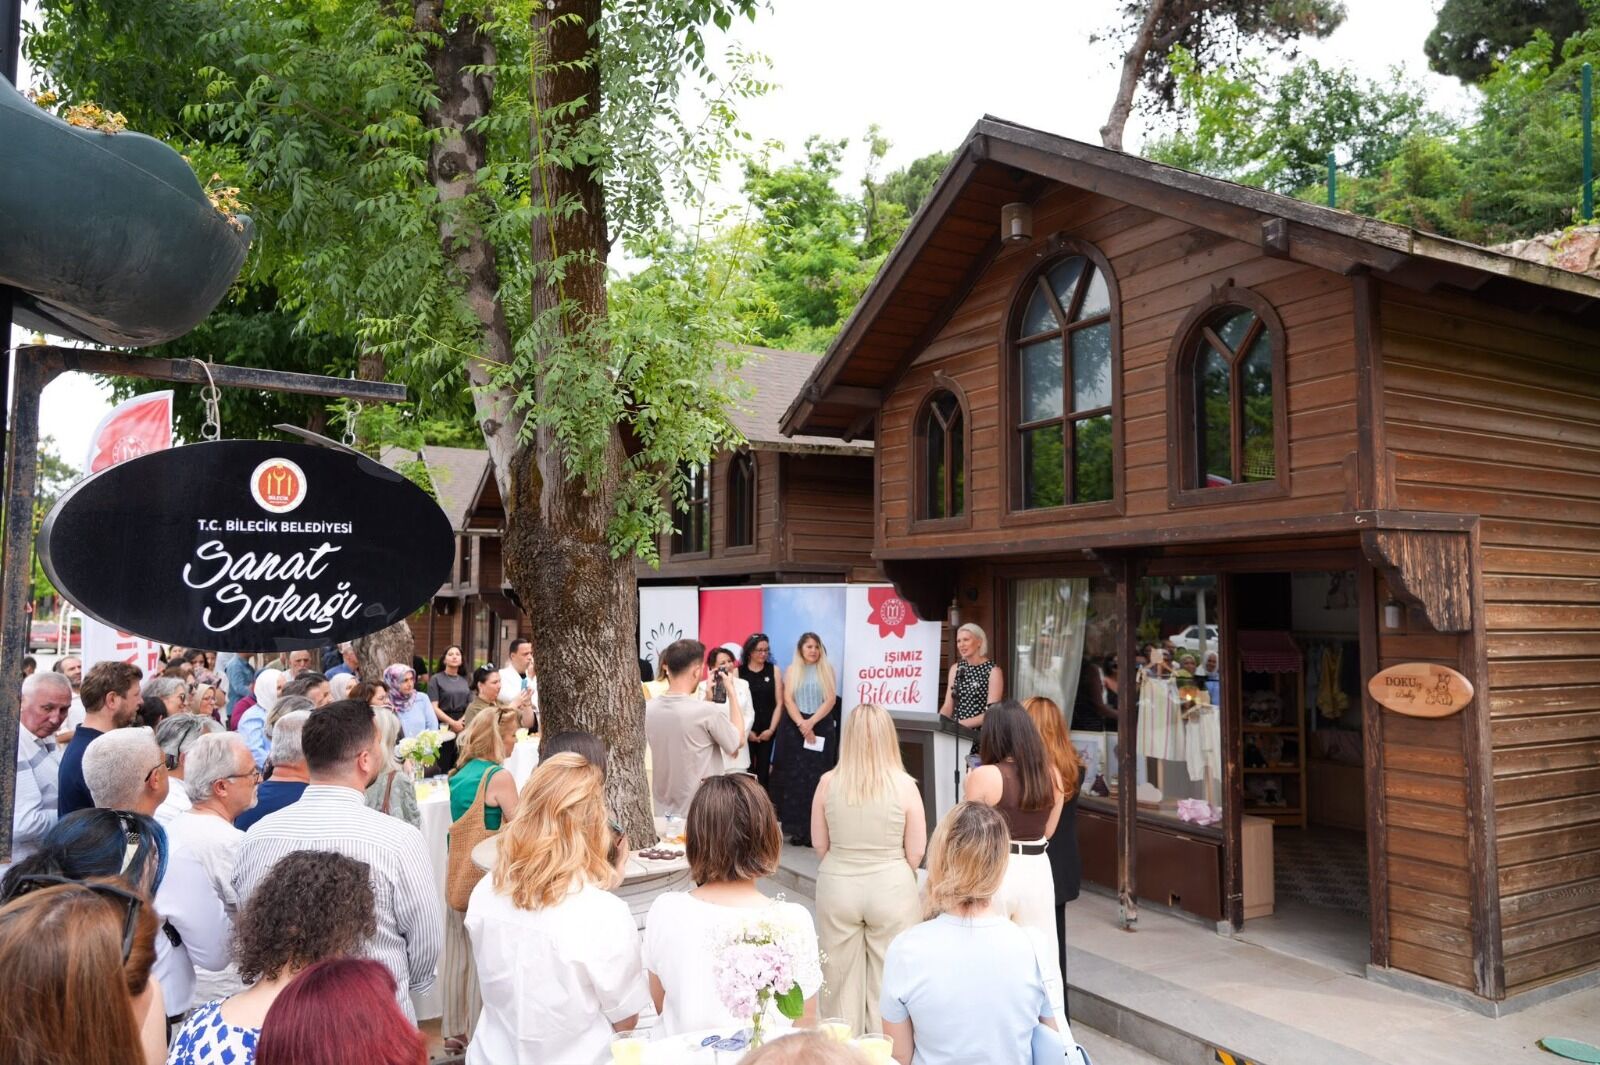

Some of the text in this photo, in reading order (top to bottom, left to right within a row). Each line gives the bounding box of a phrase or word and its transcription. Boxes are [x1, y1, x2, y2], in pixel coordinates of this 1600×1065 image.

[197, 517, 353, 534] T.C. BİLECİK BELEDİYESİ
[182, 539, 342, 589] Sanat
[202, 581, 363, 634] Sokağı
[884, 650, 923, 664] İŞİMİZ
[858, 664, 922, 679] GÜCÜMÜZ
[857, 680, 922, 705] Bilecik
